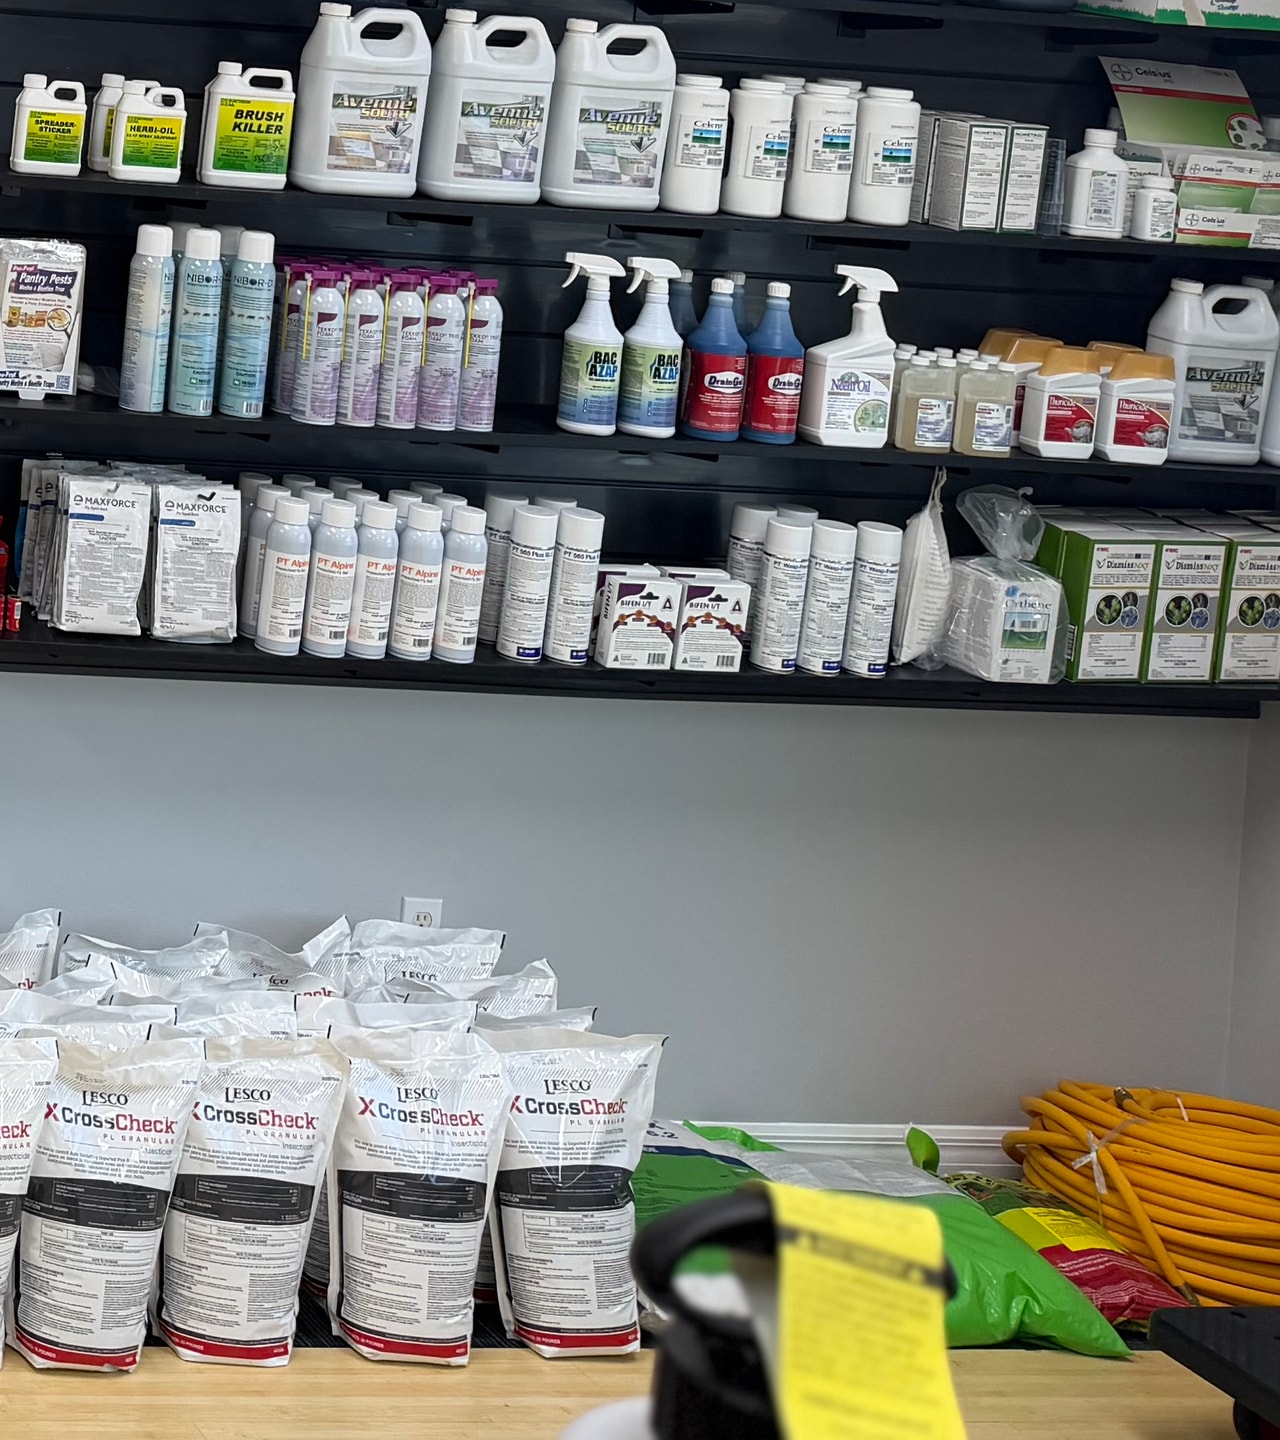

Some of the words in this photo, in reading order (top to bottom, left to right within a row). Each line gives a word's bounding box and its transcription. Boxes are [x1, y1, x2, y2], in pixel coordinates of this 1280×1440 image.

[335, 93, 414, 109] Avenue
[233, 109, 284, 122] BRUSH
[464, 102, 541, 119] Avenue
[35, 119, 77, 129] SPREADER-
[38, 126, 72, 136] STICKER
[130, 125, 176, 135] HERBI-OIL
[232, 121, 283, 135] KILLER
[19, 272, 48, 286] Pantry
[49, 273, 72, 285] Pests
[594, 351, 617, 365] BAC
[590, 364, 618, 378] AZAP
[856, 379, 871, 393] Oil
[84, 497, 136, 509] MAXFORCE
[176, 502, 227, 514] MAXFORCE
[276, 557, 289, 566] PT
[291, 559, 309, 569] Alpin
[317, 557, 329, 565] PT
[1106, 560, 1134, 569] Dismiss
[1176, 561, 1203, 570] Dismiss
[401, 565, 413, 575] PT
[544, 1079, 591, 1095] LESCO
[82, 1090, 128, 1106] LESCO
[225, 1087, 271, 1103] LESCO
[396, 1087, 439, 1103] LESCO
[525, 1097, 626, 1115] CrossCheck
[61, 1106, 176, 1134] CrossCheck
[203, 1105, 317, 1130] CrossCheck
[378, 1102, 484, 1127] CrossCheck
